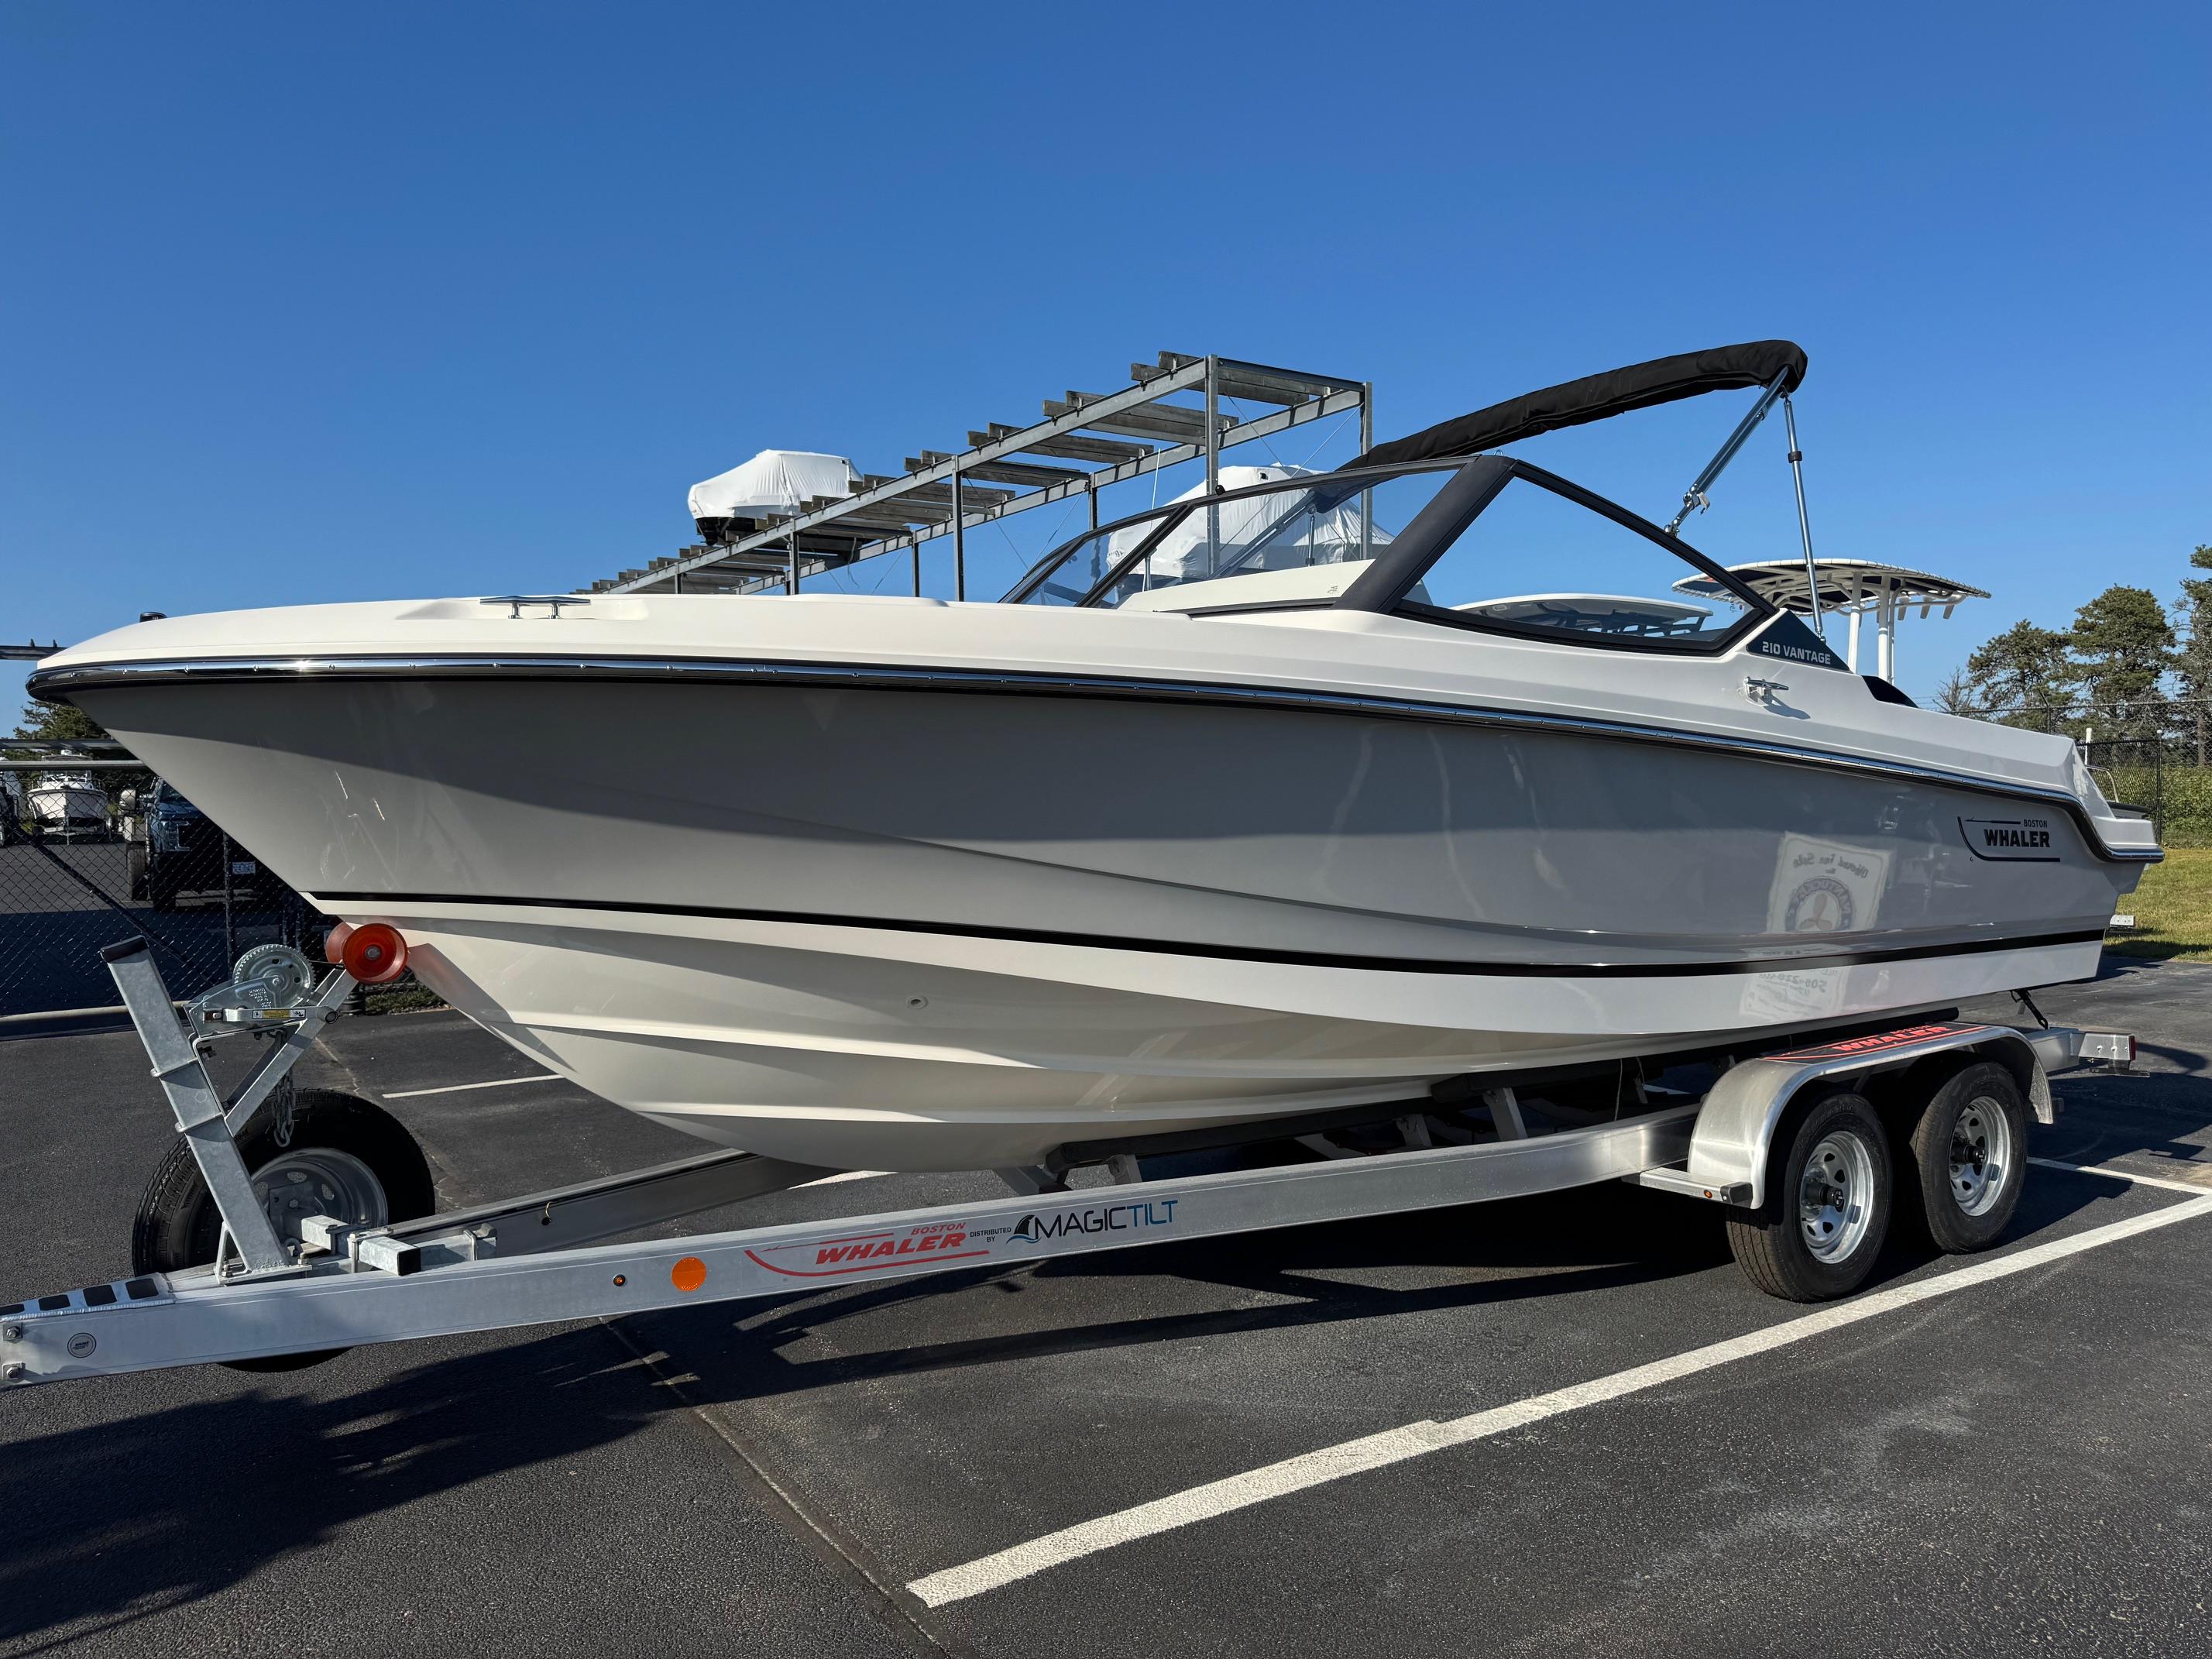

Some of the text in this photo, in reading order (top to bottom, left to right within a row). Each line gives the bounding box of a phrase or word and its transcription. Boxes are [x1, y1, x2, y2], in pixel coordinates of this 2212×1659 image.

[1762, 641, 1830, 665] 210 VANTAGE
[2024, 819, 2047, 828] BOSTON
[1984, 830, 2050, 847] WHALER
[1832, 1026, 1953, 1052] WHALER
[912, 1223, 966, 1235] BOSTON
[1035, 1200, 1177, 1239] MAGICTILT
[970, 1228, 1012, 1238] DISTRIBUTED
[816, 1233, 966, 1264] WHALER
